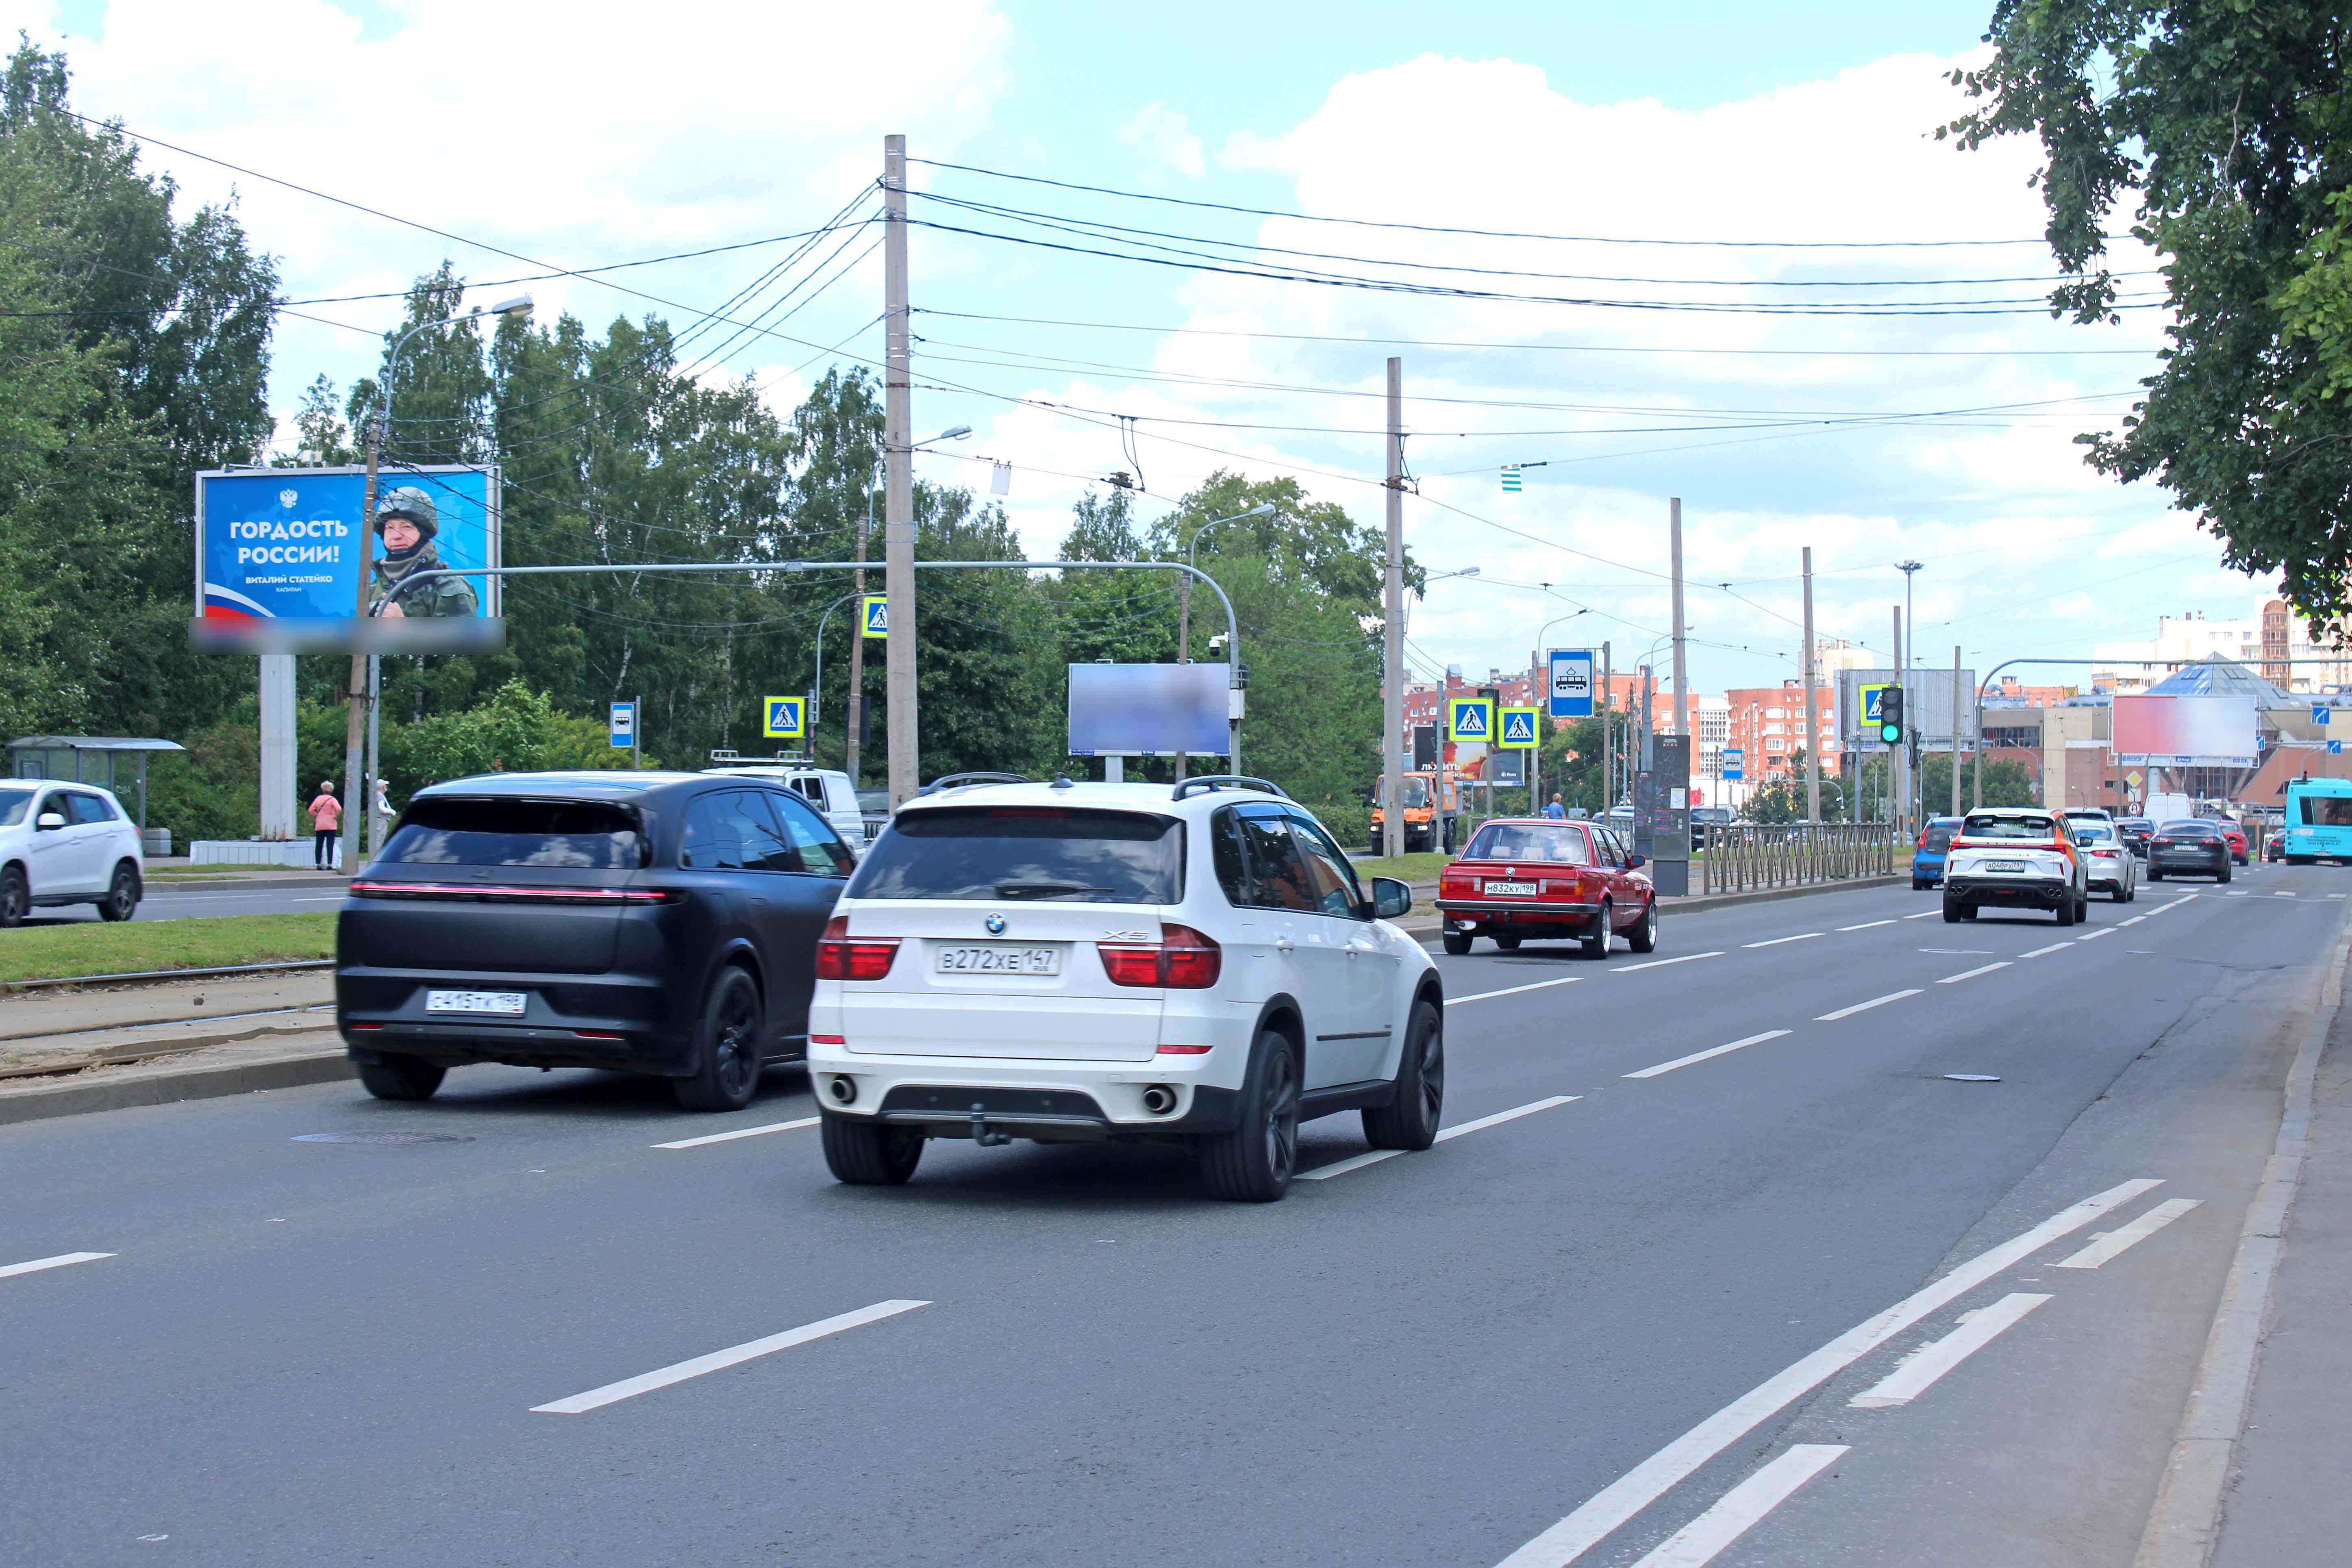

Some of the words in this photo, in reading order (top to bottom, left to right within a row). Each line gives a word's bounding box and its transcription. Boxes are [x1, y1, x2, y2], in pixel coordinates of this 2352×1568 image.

[230, 520, 348, 540] ГОРДОСТЬ
[238, 546, 339, 564] РОССИИ!
[246, 575, 287, 584] ВИТАЛИЙ
[289, 574, 332, 583] СТАТЕЙКО
[1487, 884, 1519, 893] М832КУ
[943, 949, 1018, 969] В272ХЕ
[1023, 949, 1054, 965] 147
